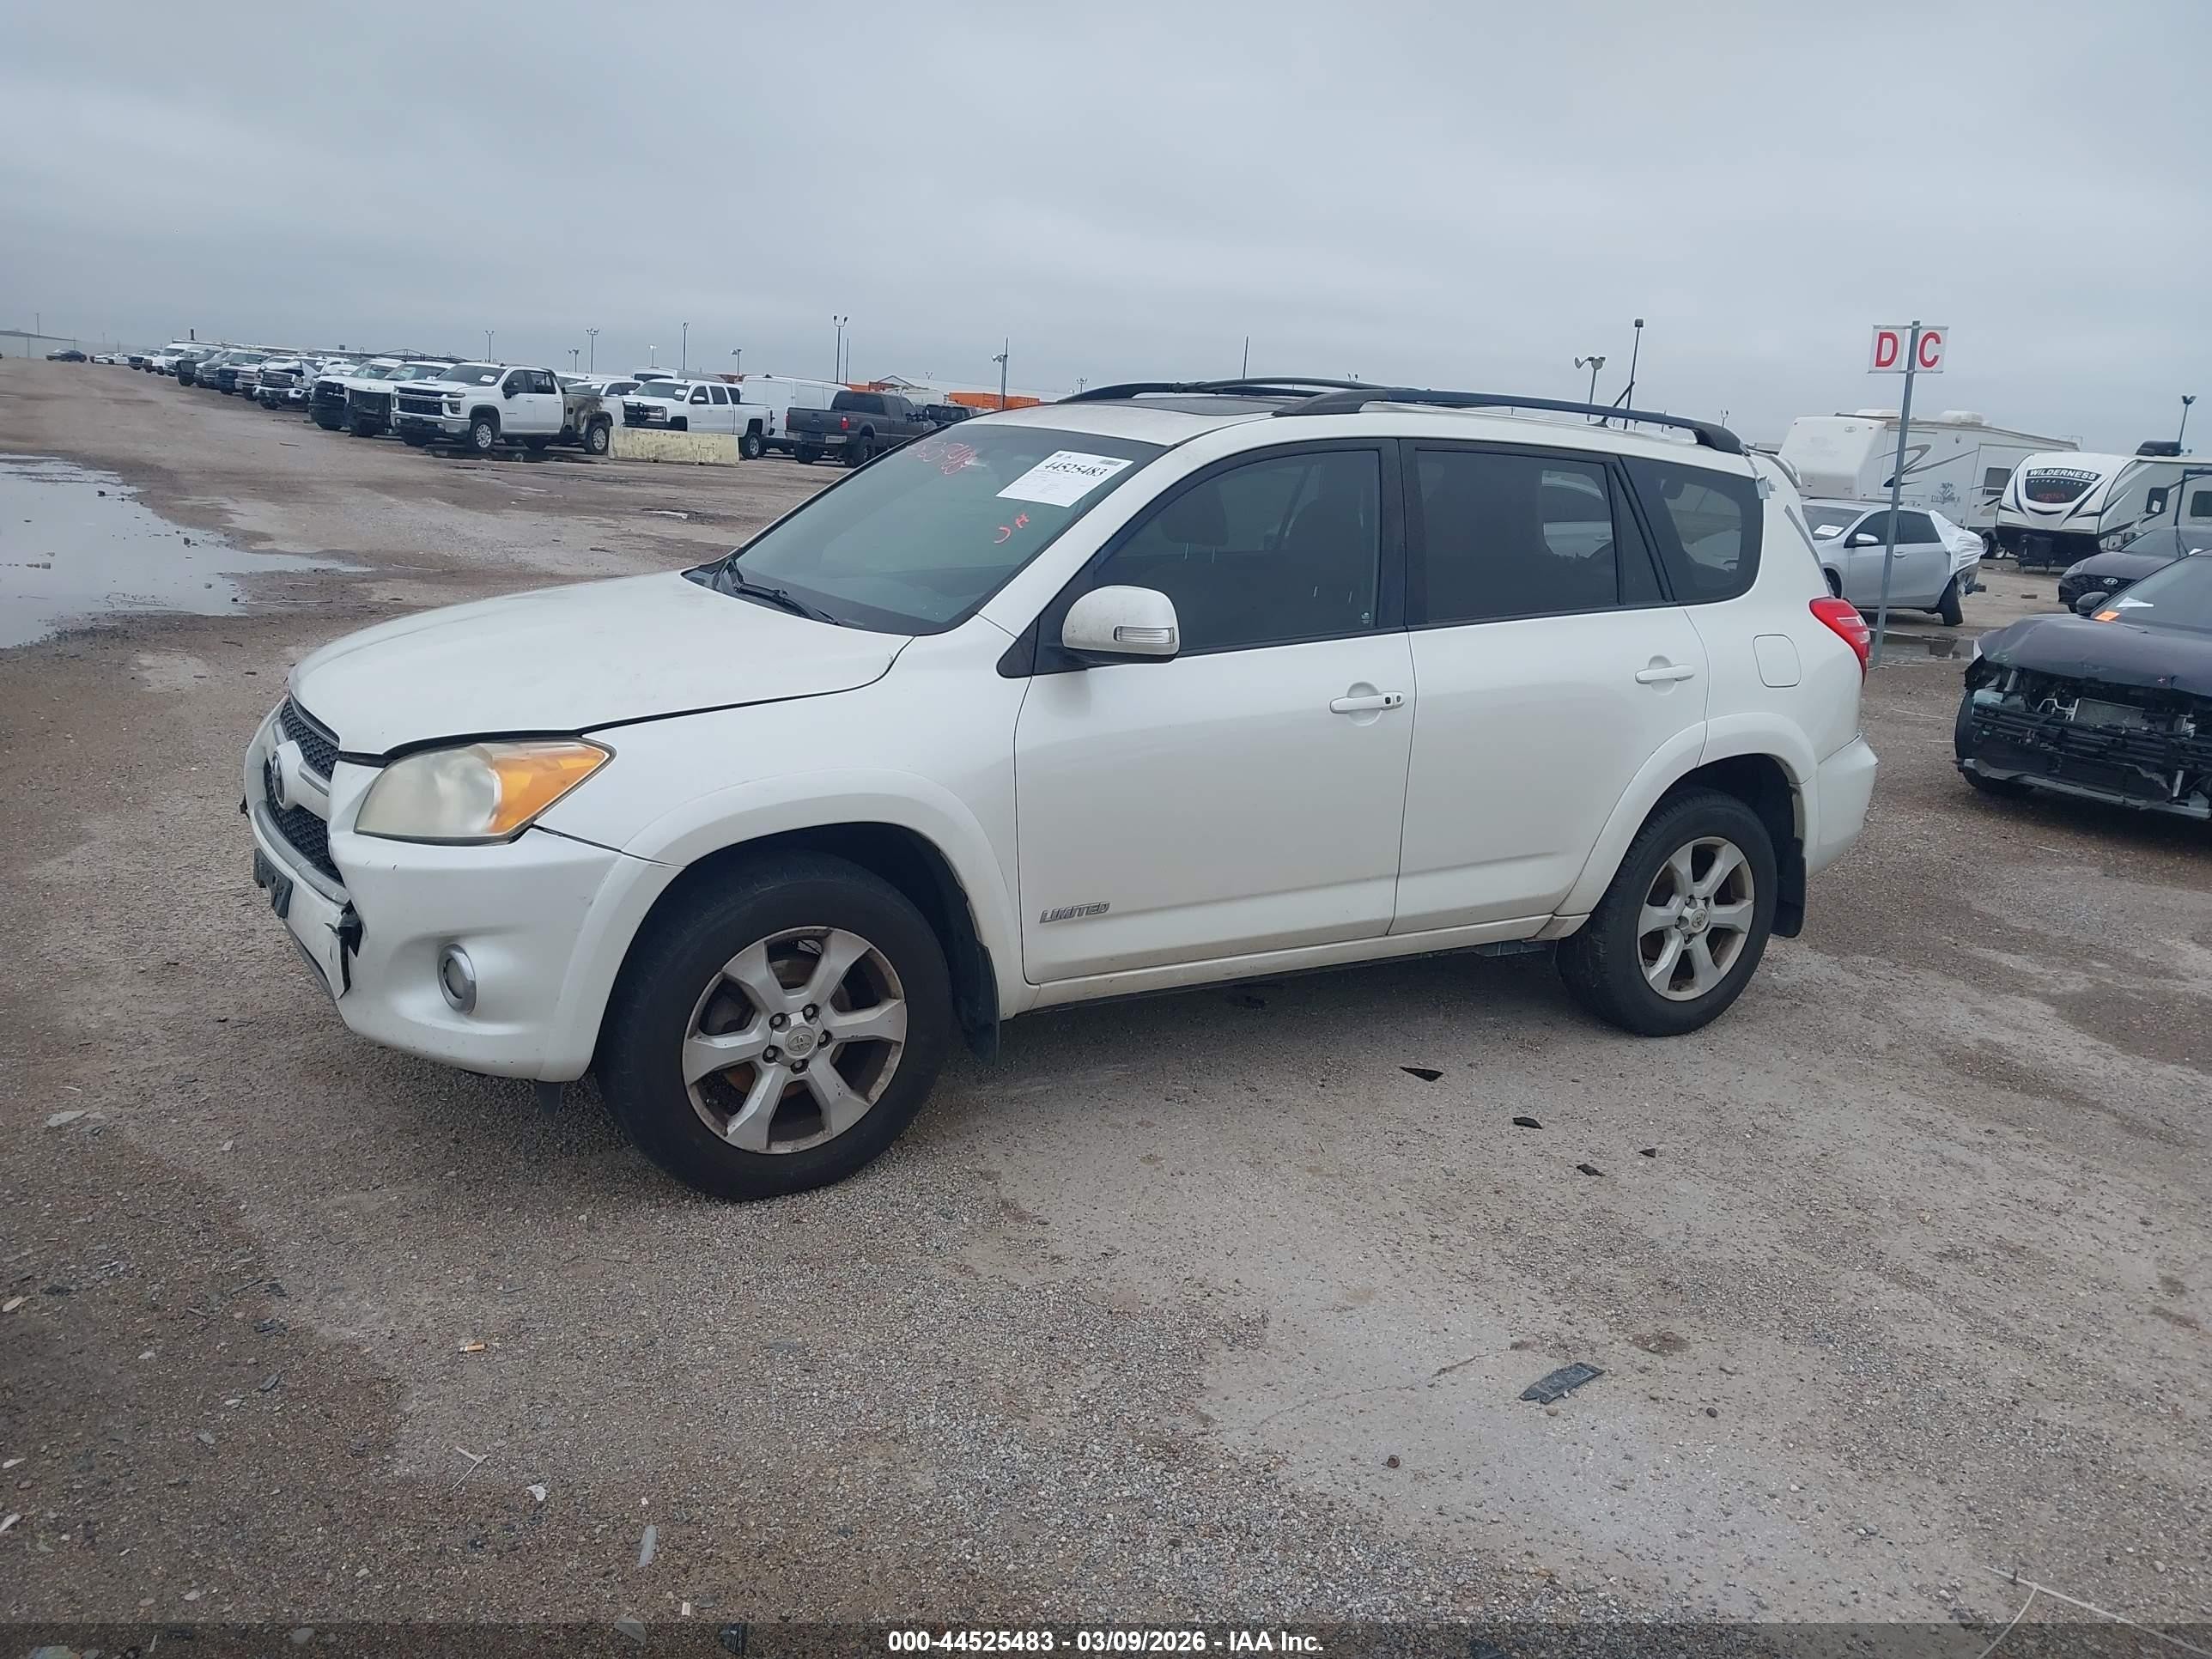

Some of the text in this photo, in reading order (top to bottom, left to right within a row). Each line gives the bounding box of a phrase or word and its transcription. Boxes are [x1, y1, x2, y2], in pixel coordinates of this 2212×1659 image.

[1875, 331, 1942, 368] D C
[1044, 461, 1108, 477] 44525483
[2028, 469, 2097, 480] WILDERNESS
[1039, 902, 1110, 923] LIMITED
